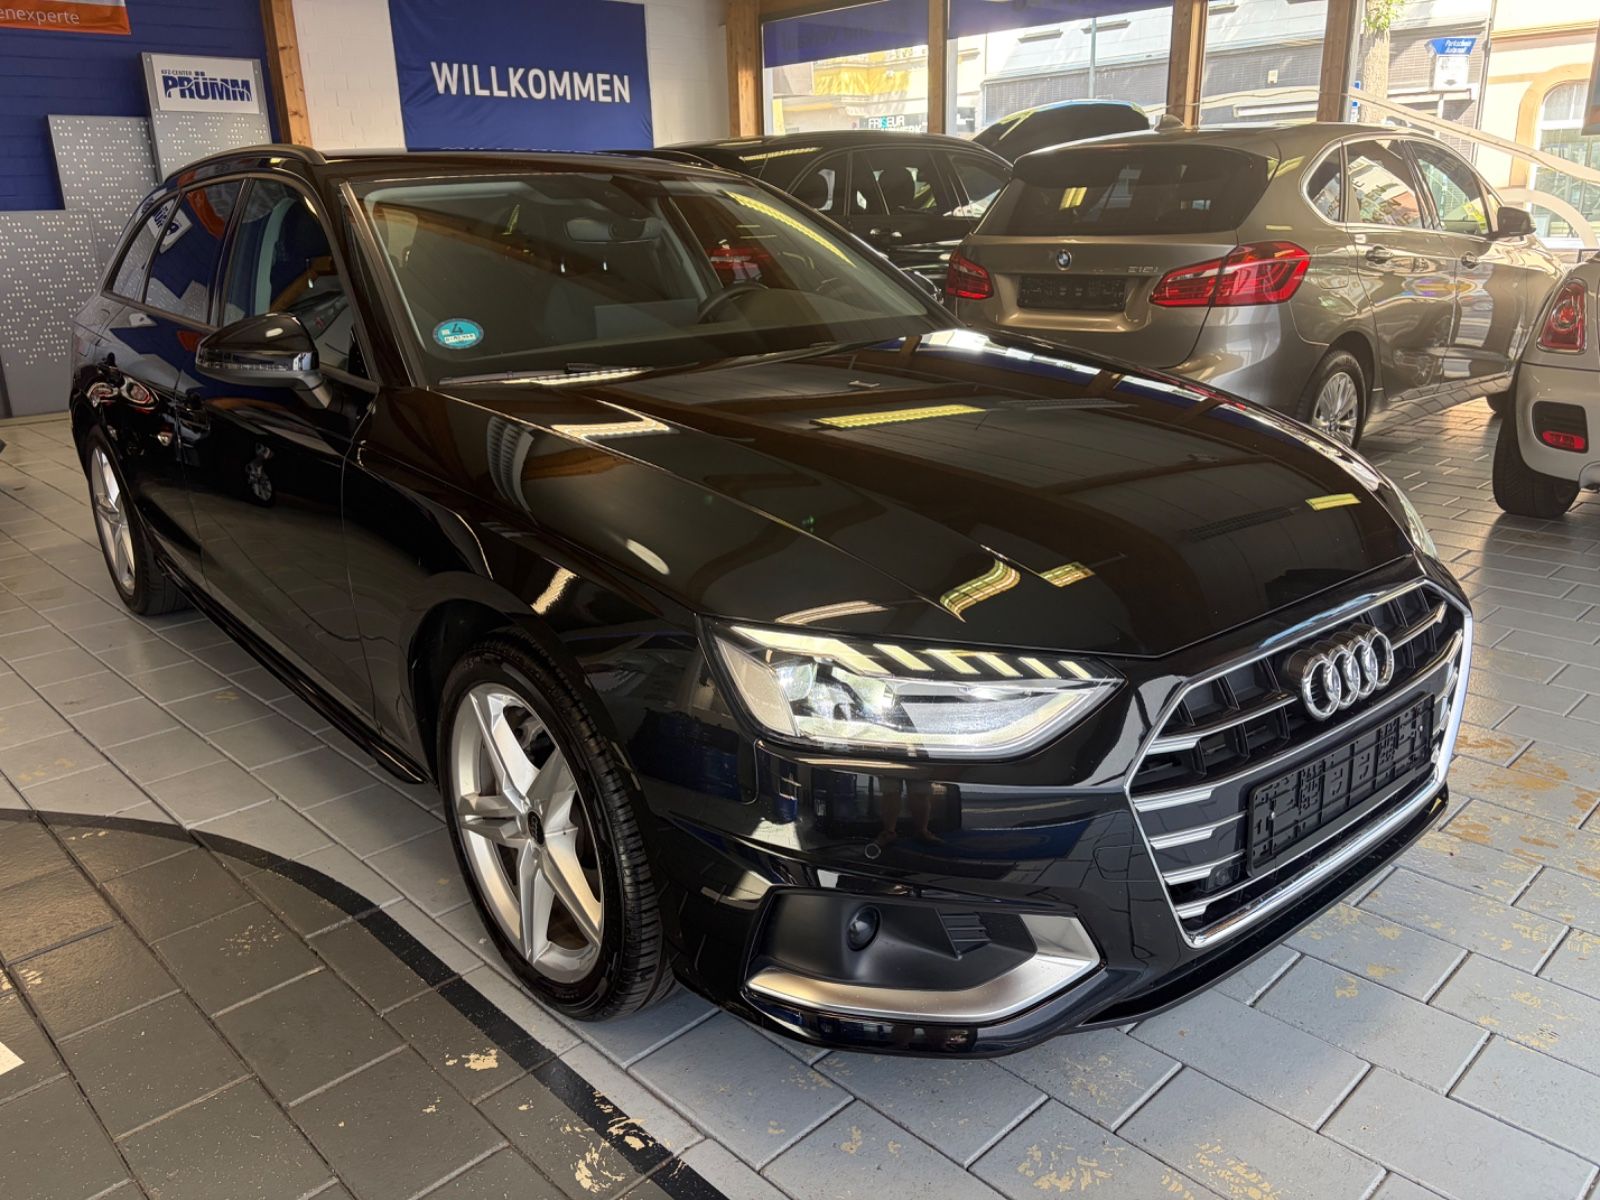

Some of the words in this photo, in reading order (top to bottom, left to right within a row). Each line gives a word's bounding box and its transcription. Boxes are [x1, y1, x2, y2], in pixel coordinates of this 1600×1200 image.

[162, 71, 252, 102] PRÜMM
[430, 61, 631, 104] WILLKOMMEN
[868, 115, 905, 129] FRISEUR
